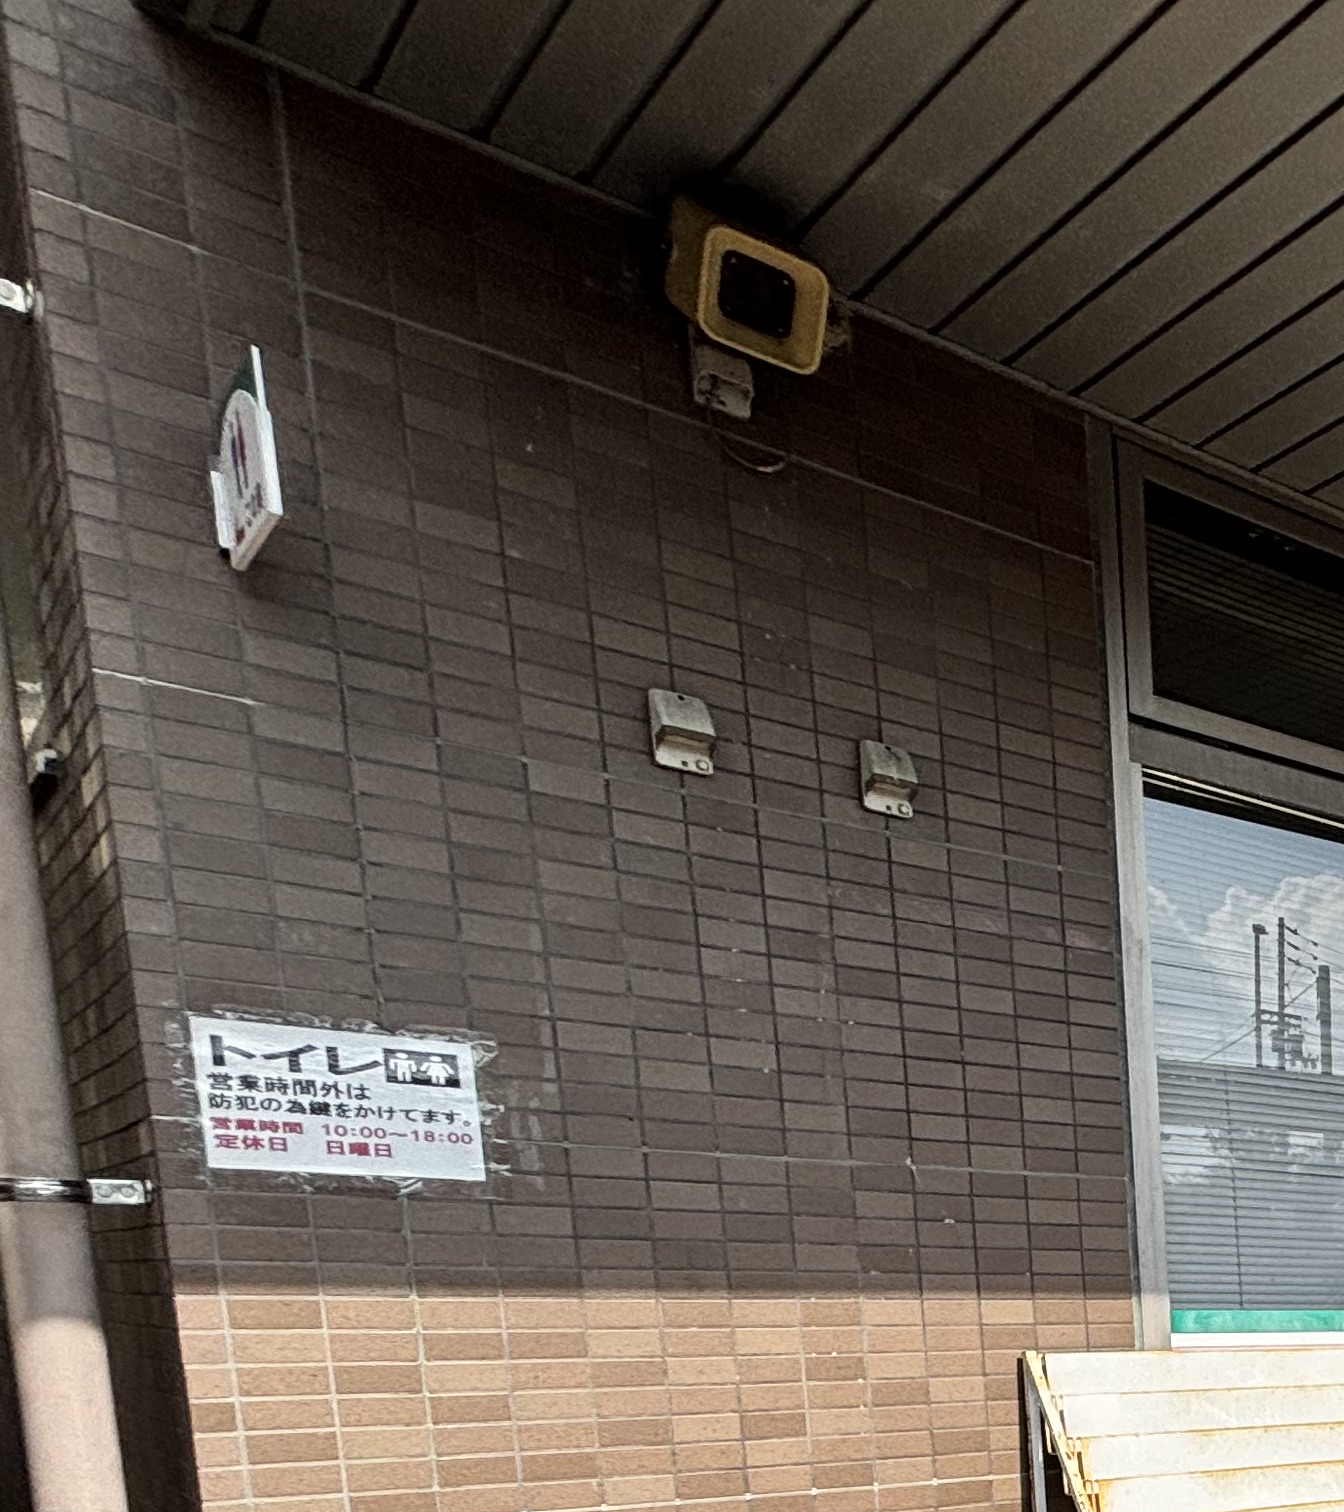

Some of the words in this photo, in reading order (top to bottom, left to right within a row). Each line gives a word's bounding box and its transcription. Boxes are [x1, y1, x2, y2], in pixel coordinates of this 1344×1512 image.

[209, 1034, 384, 1076] トイレ
[206, 1072, 372, 1101] 営業時間外は
[208, 1116, 304, 1136] 営業時間
[213, 1133, 289, 1152] 定休日
[325, 1140, 394, 1159] 日曜日
